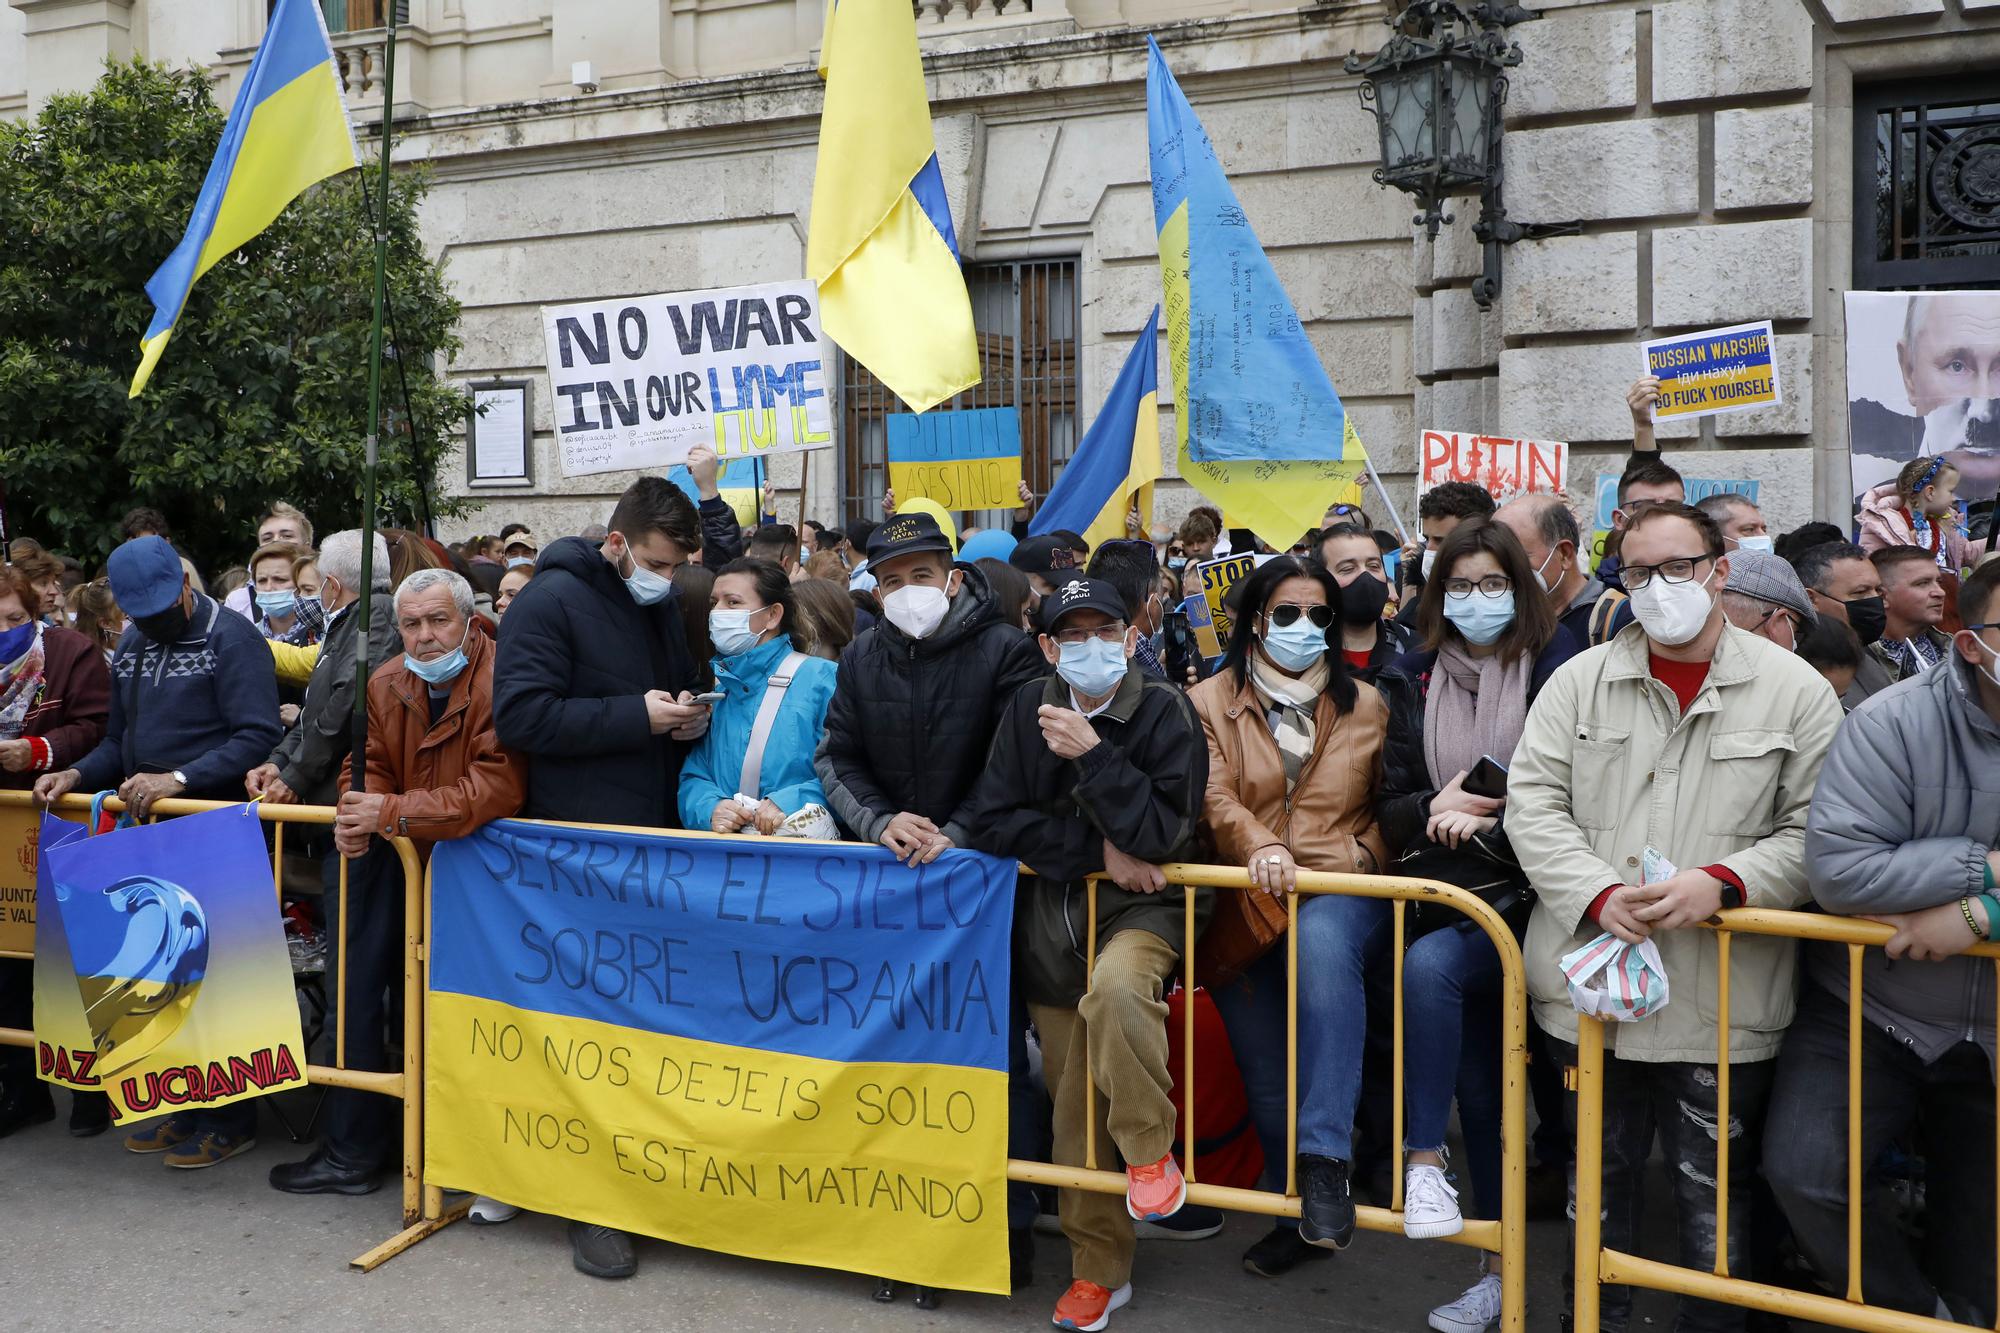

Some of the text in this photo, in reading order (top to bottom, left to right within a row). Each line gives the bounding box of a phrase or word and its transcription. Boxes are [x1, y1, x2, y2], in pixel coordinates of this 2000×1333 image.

[556, 294, 817, 368] NO WAR
[1649, 334, 1769, 370] RUSSIAN WARSHIP
[1674, 386, 1707, 406] FUCK
[1710, 377, 1775, 400] YOURSELF
[1676, 360, 1747, 387] іди нахуй
[556, 378, 640, 433] IN
[646, 371, 706, 422] OUR
[707, 360, 830, 456] HOME
[908, 410, 1001, 457] PUTIN
[904, 462, 1003, 509] ASESINO
[1424, 431, 1562, 495] PUTIN
[1070, 592, 1090, 601] PAULI
[1201, 559, 1254, 590] STOP
[716, 851, 783, 926] EL
[802, 855, 990, 931] SIELO
[514, 921, 999, 1036] SOBRE UCRANIA
[121, 1043, 301, 1113] UCRANIA
[471, 1018, 977, 1134] NO NOS DEJEIS SOLO
[503, 1107, 984, 1224] NOS ESTAN MATANDO
